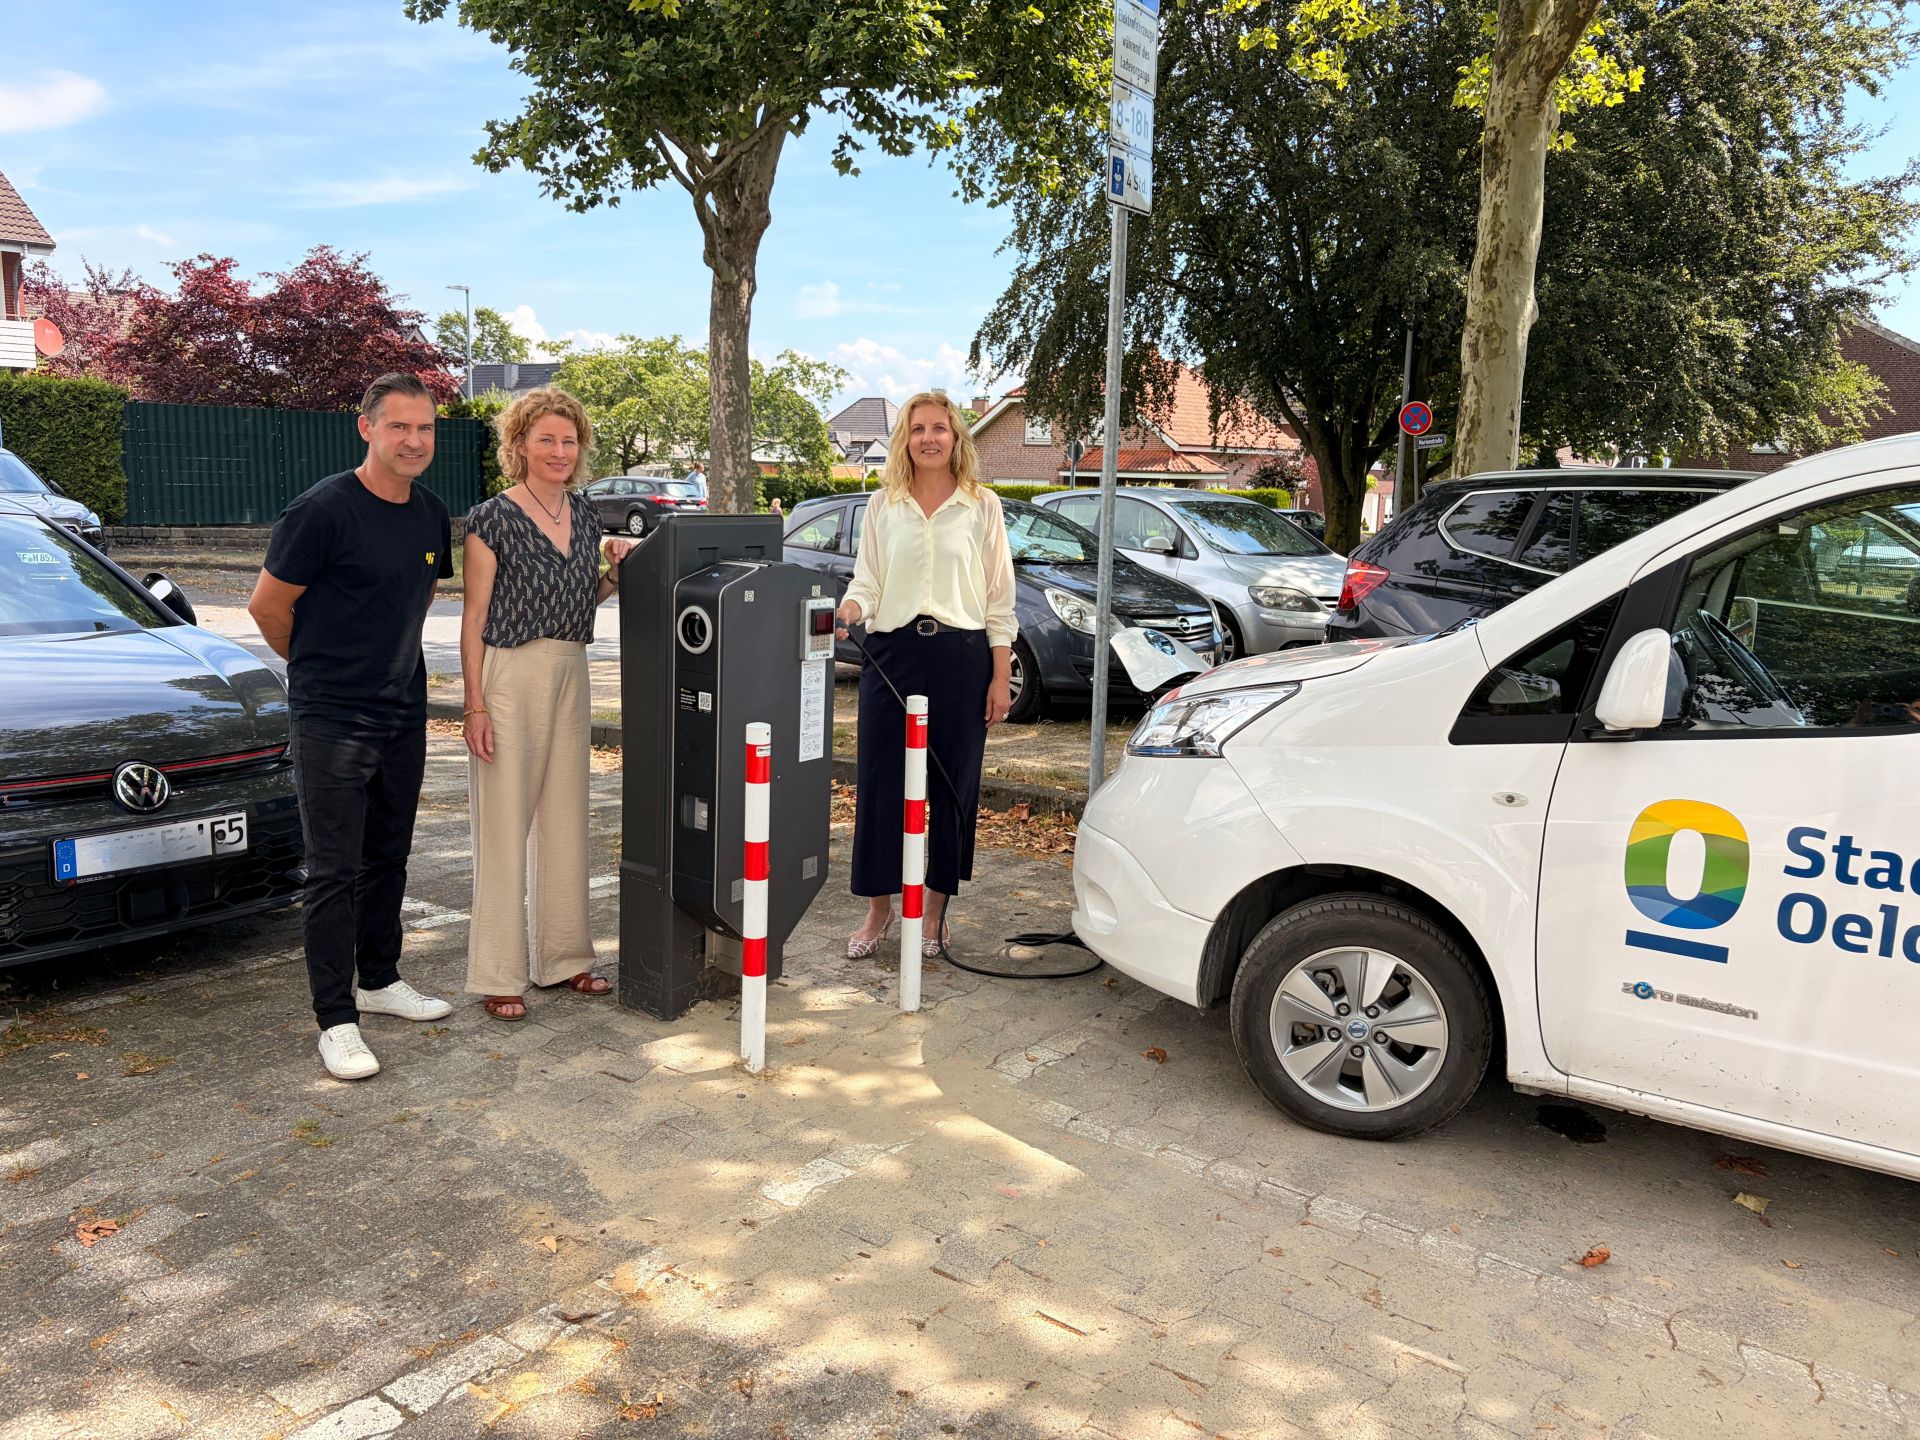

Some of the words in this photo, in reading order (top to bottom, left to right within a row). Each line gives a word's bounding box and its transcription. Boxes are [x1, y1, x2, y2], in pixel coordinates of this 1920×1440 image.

[1122, 35, 1141, 56] während
[1141, 46, 1150, 61] des
[1126, 172, 1131, 188] 4
[1620, 981, 1674, 1003] zero
[1676, 993, 1760, 1020] emission
